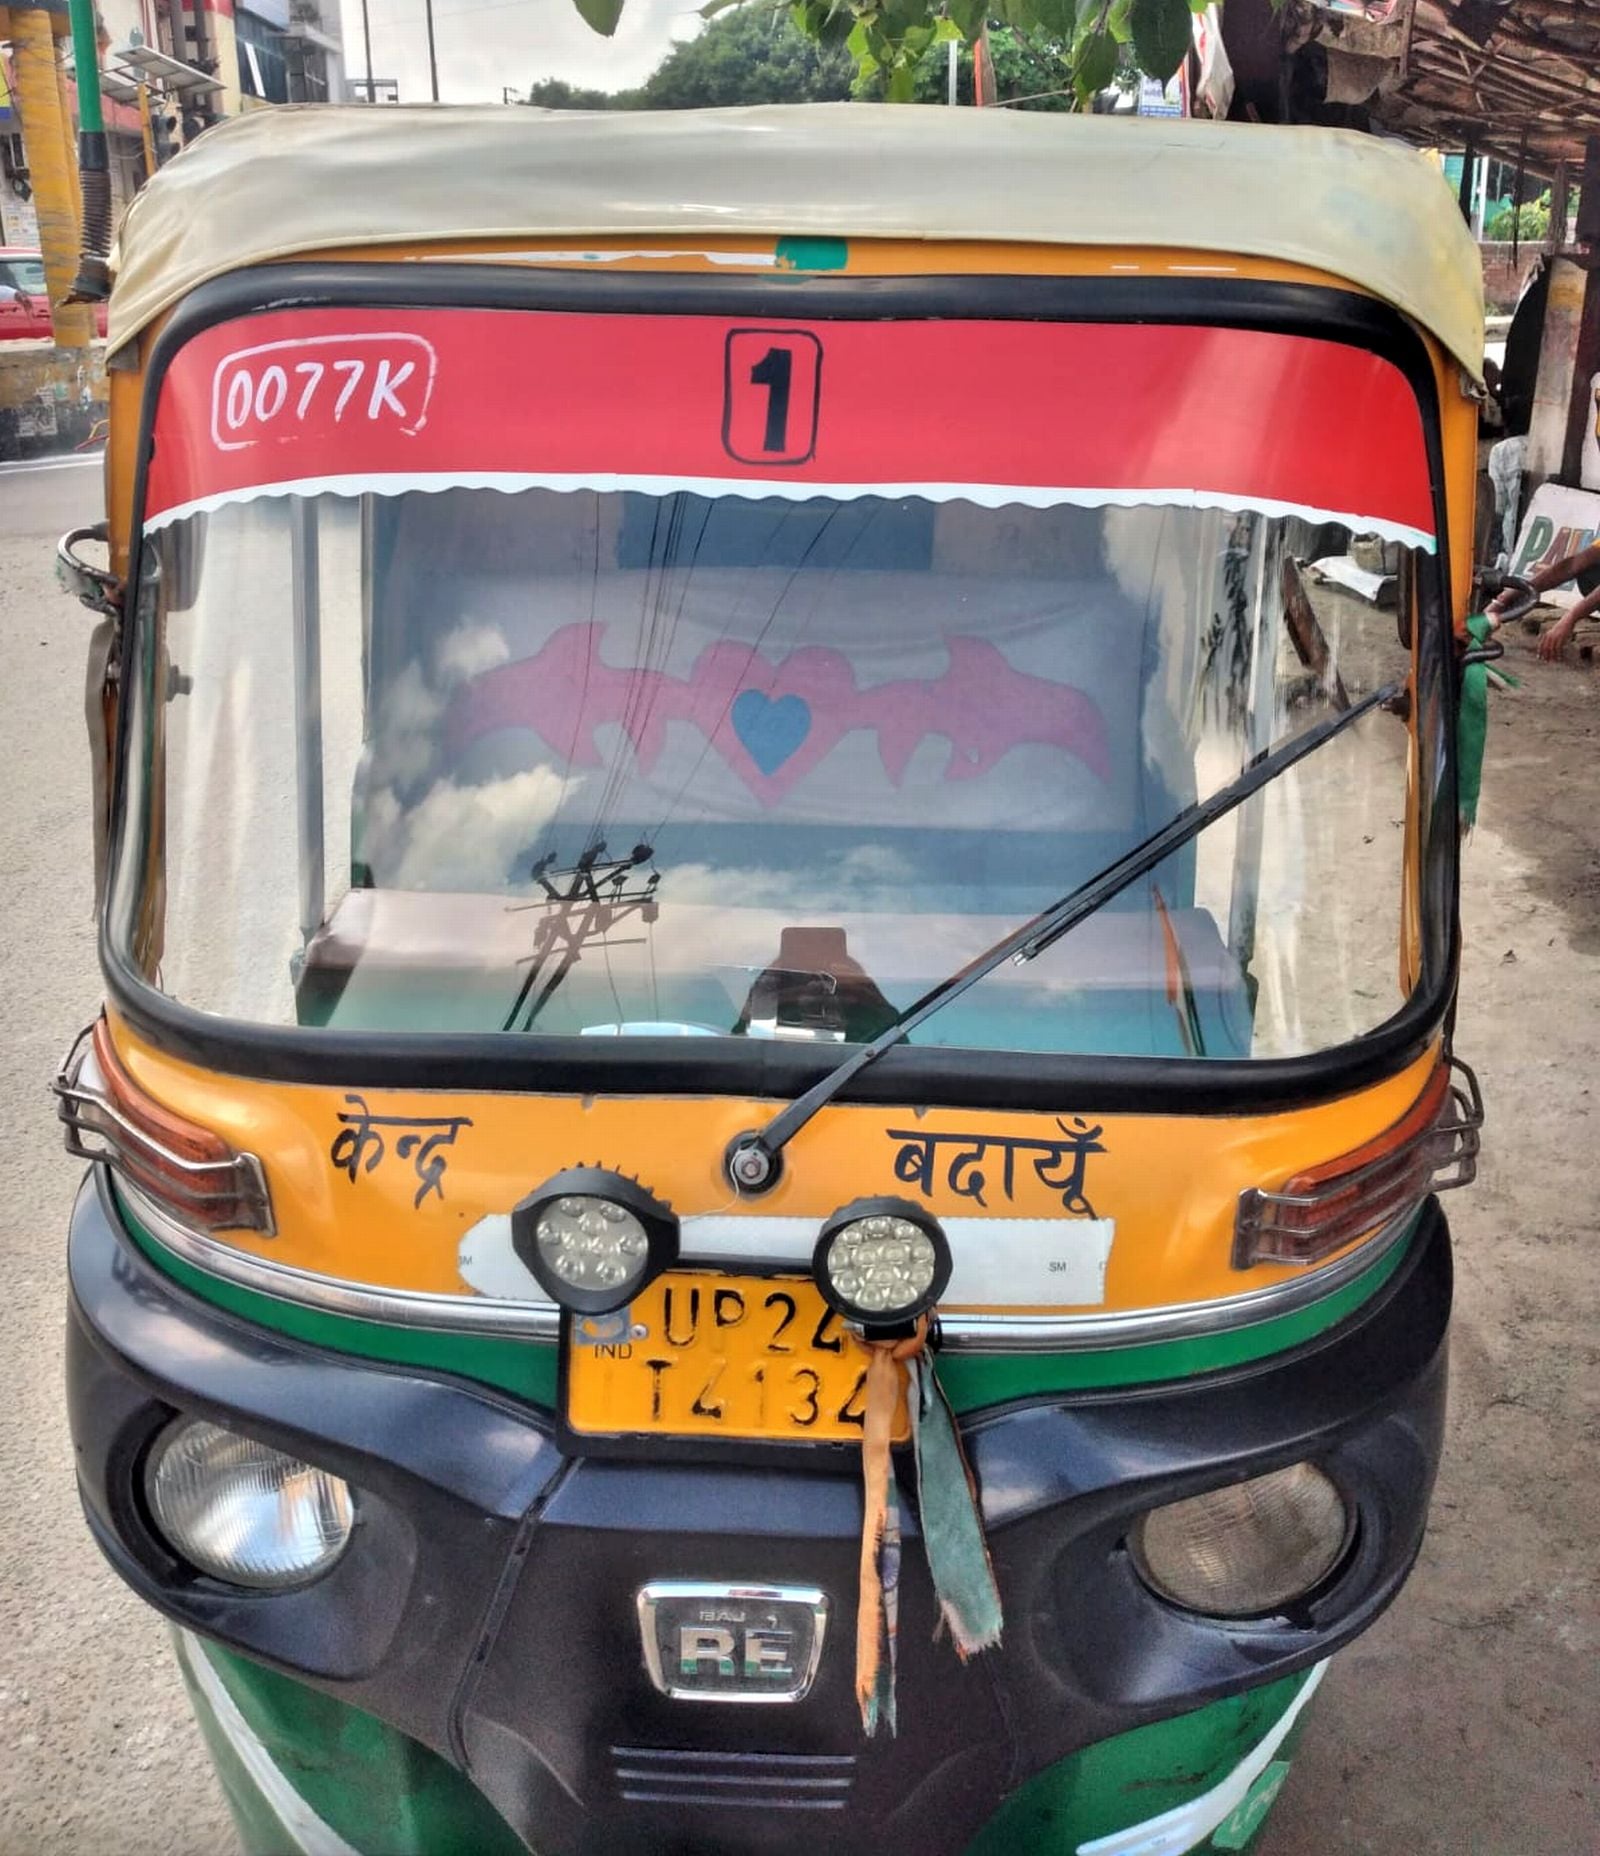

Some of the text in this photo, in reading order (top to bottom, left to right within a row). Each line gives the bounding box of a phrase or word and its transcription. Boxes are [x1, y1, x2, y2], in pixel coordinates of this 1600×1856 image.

[226, 359, 415, 430] 0077K
[751, 347, 793, 453] 1
[331, 1094, 473, 1209] केन्द्र
[594, 1344, 633, 1360] IND
[680, 1625, 793, 1678] RE
